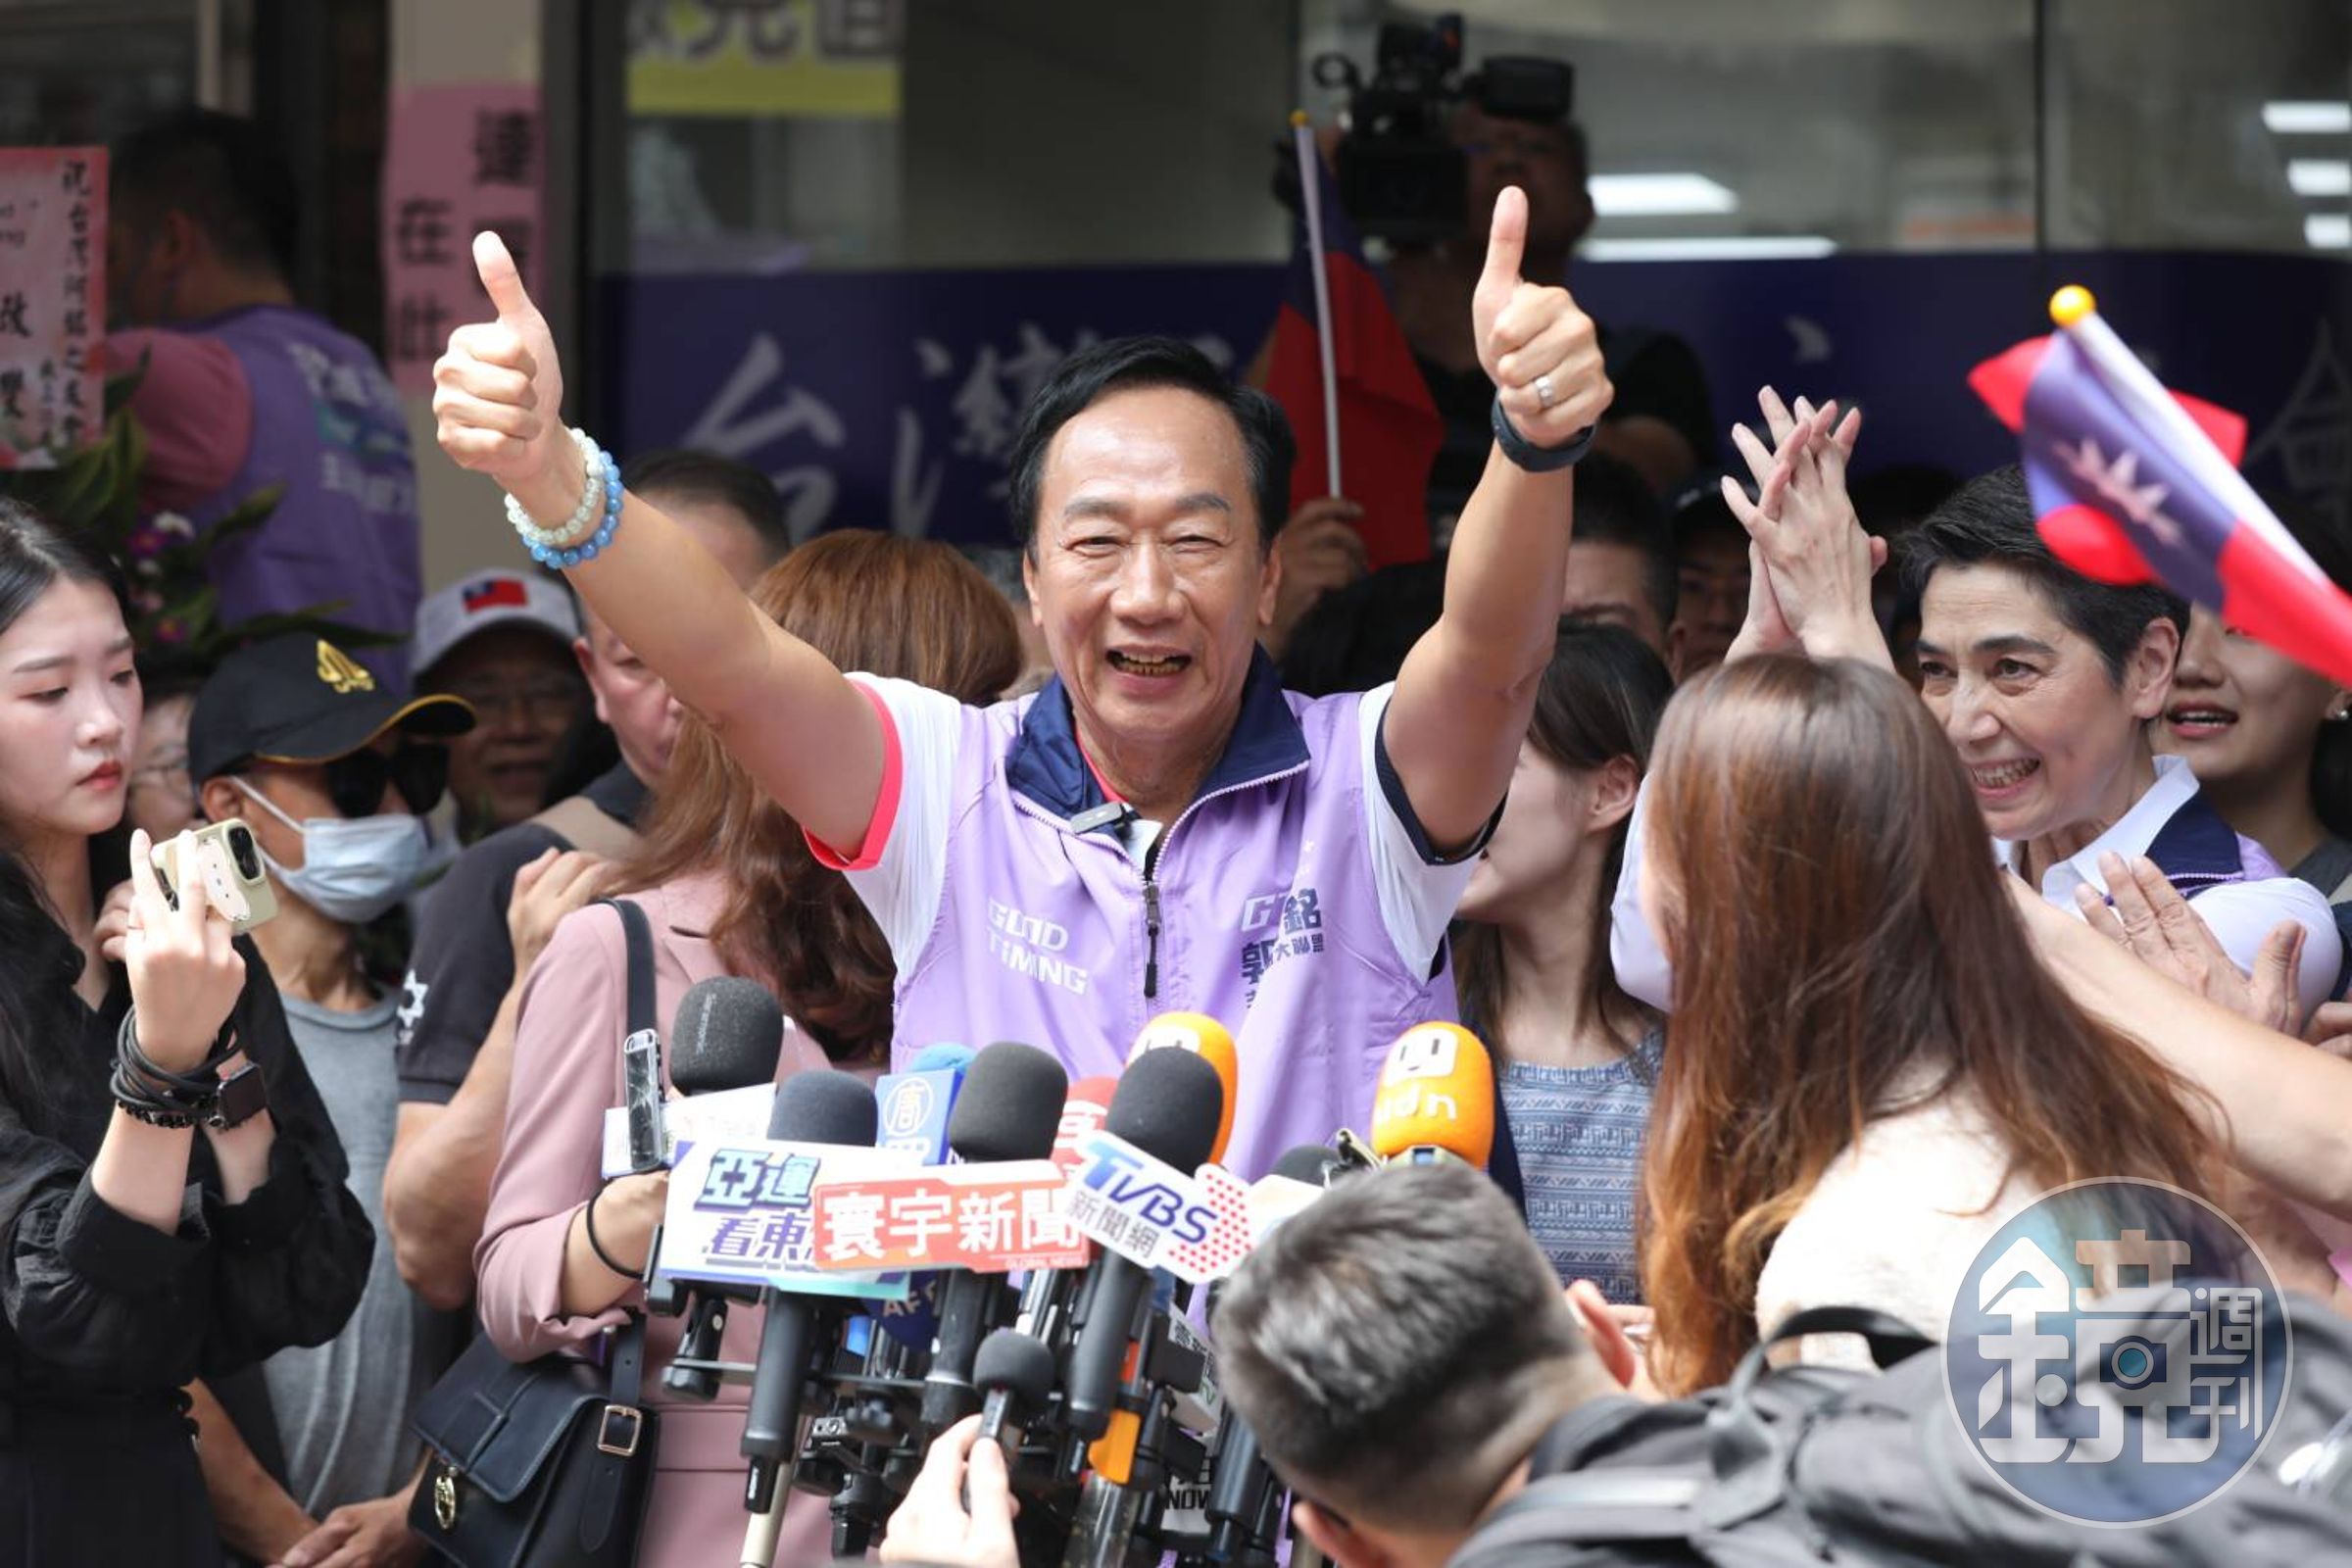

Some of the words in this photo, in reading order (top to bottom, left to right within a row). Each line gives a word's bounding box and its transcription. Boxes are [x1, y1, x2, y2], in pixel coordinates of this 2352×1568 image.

[693, 1149, 822, 1215] 亞運
[1083, 1140, 1219, 1245] TVBS
[709, 1211, 815, 1262] 看東
[822, 1187, 1081, 1260] 寰宇新聞
[1066, 1190, 1160, 1259] 新聞網
